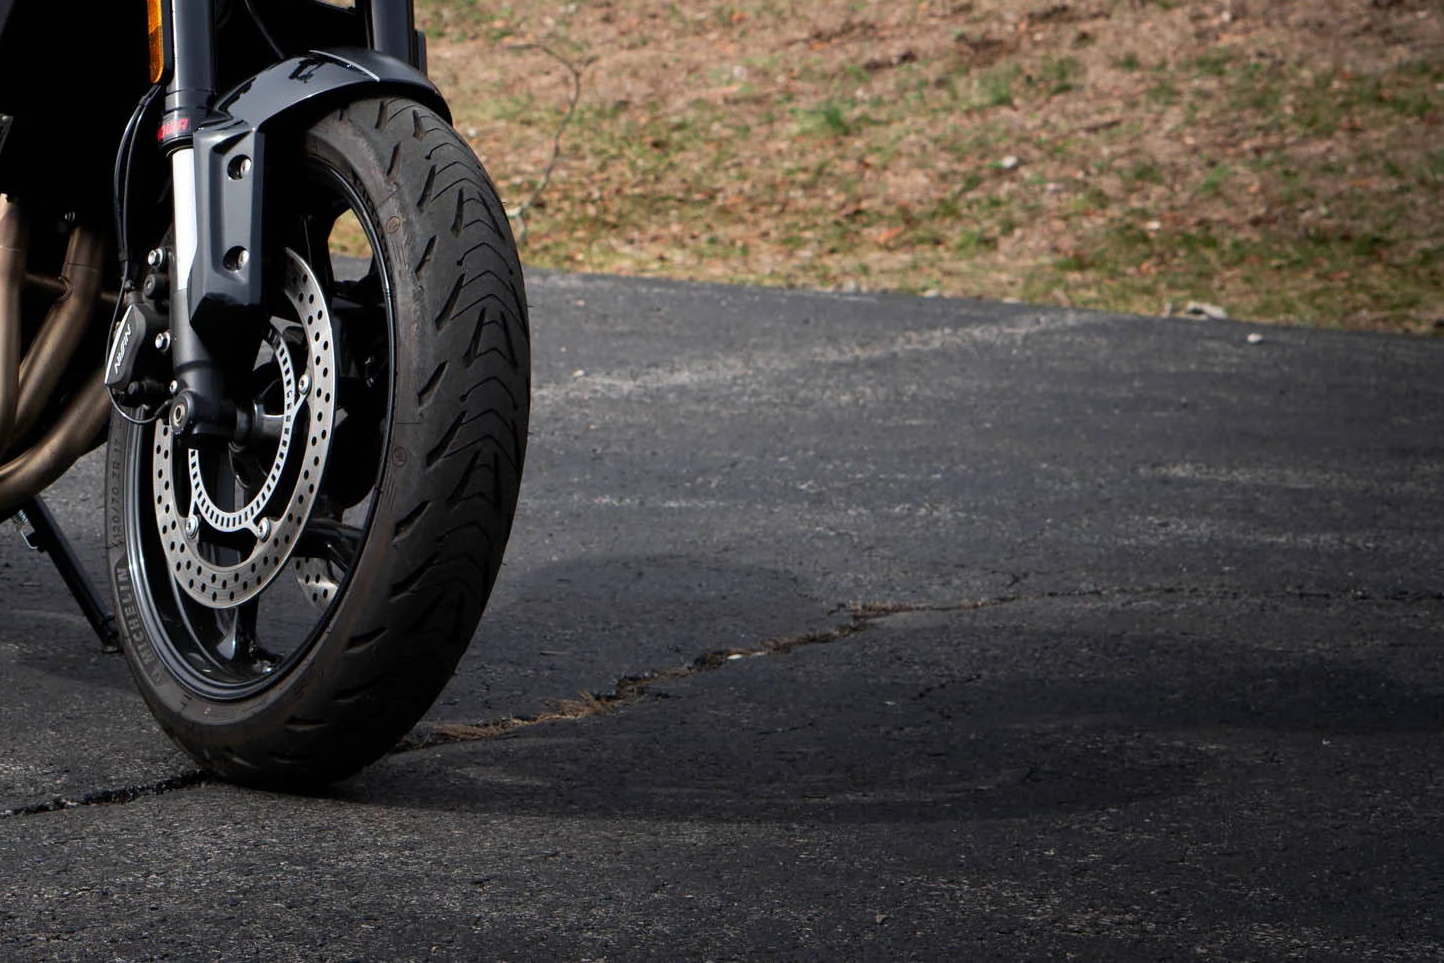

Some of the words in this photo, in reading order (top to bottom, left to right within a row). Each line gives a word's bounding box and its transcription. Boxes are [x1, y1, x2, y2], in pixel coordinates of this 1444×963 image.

[114, 439, 122, 452] 17
[112, 461, 121, 478] ZR
[111, 486, 121, 538] 120/70
[117, 568, 155, 665] MICHELIN
